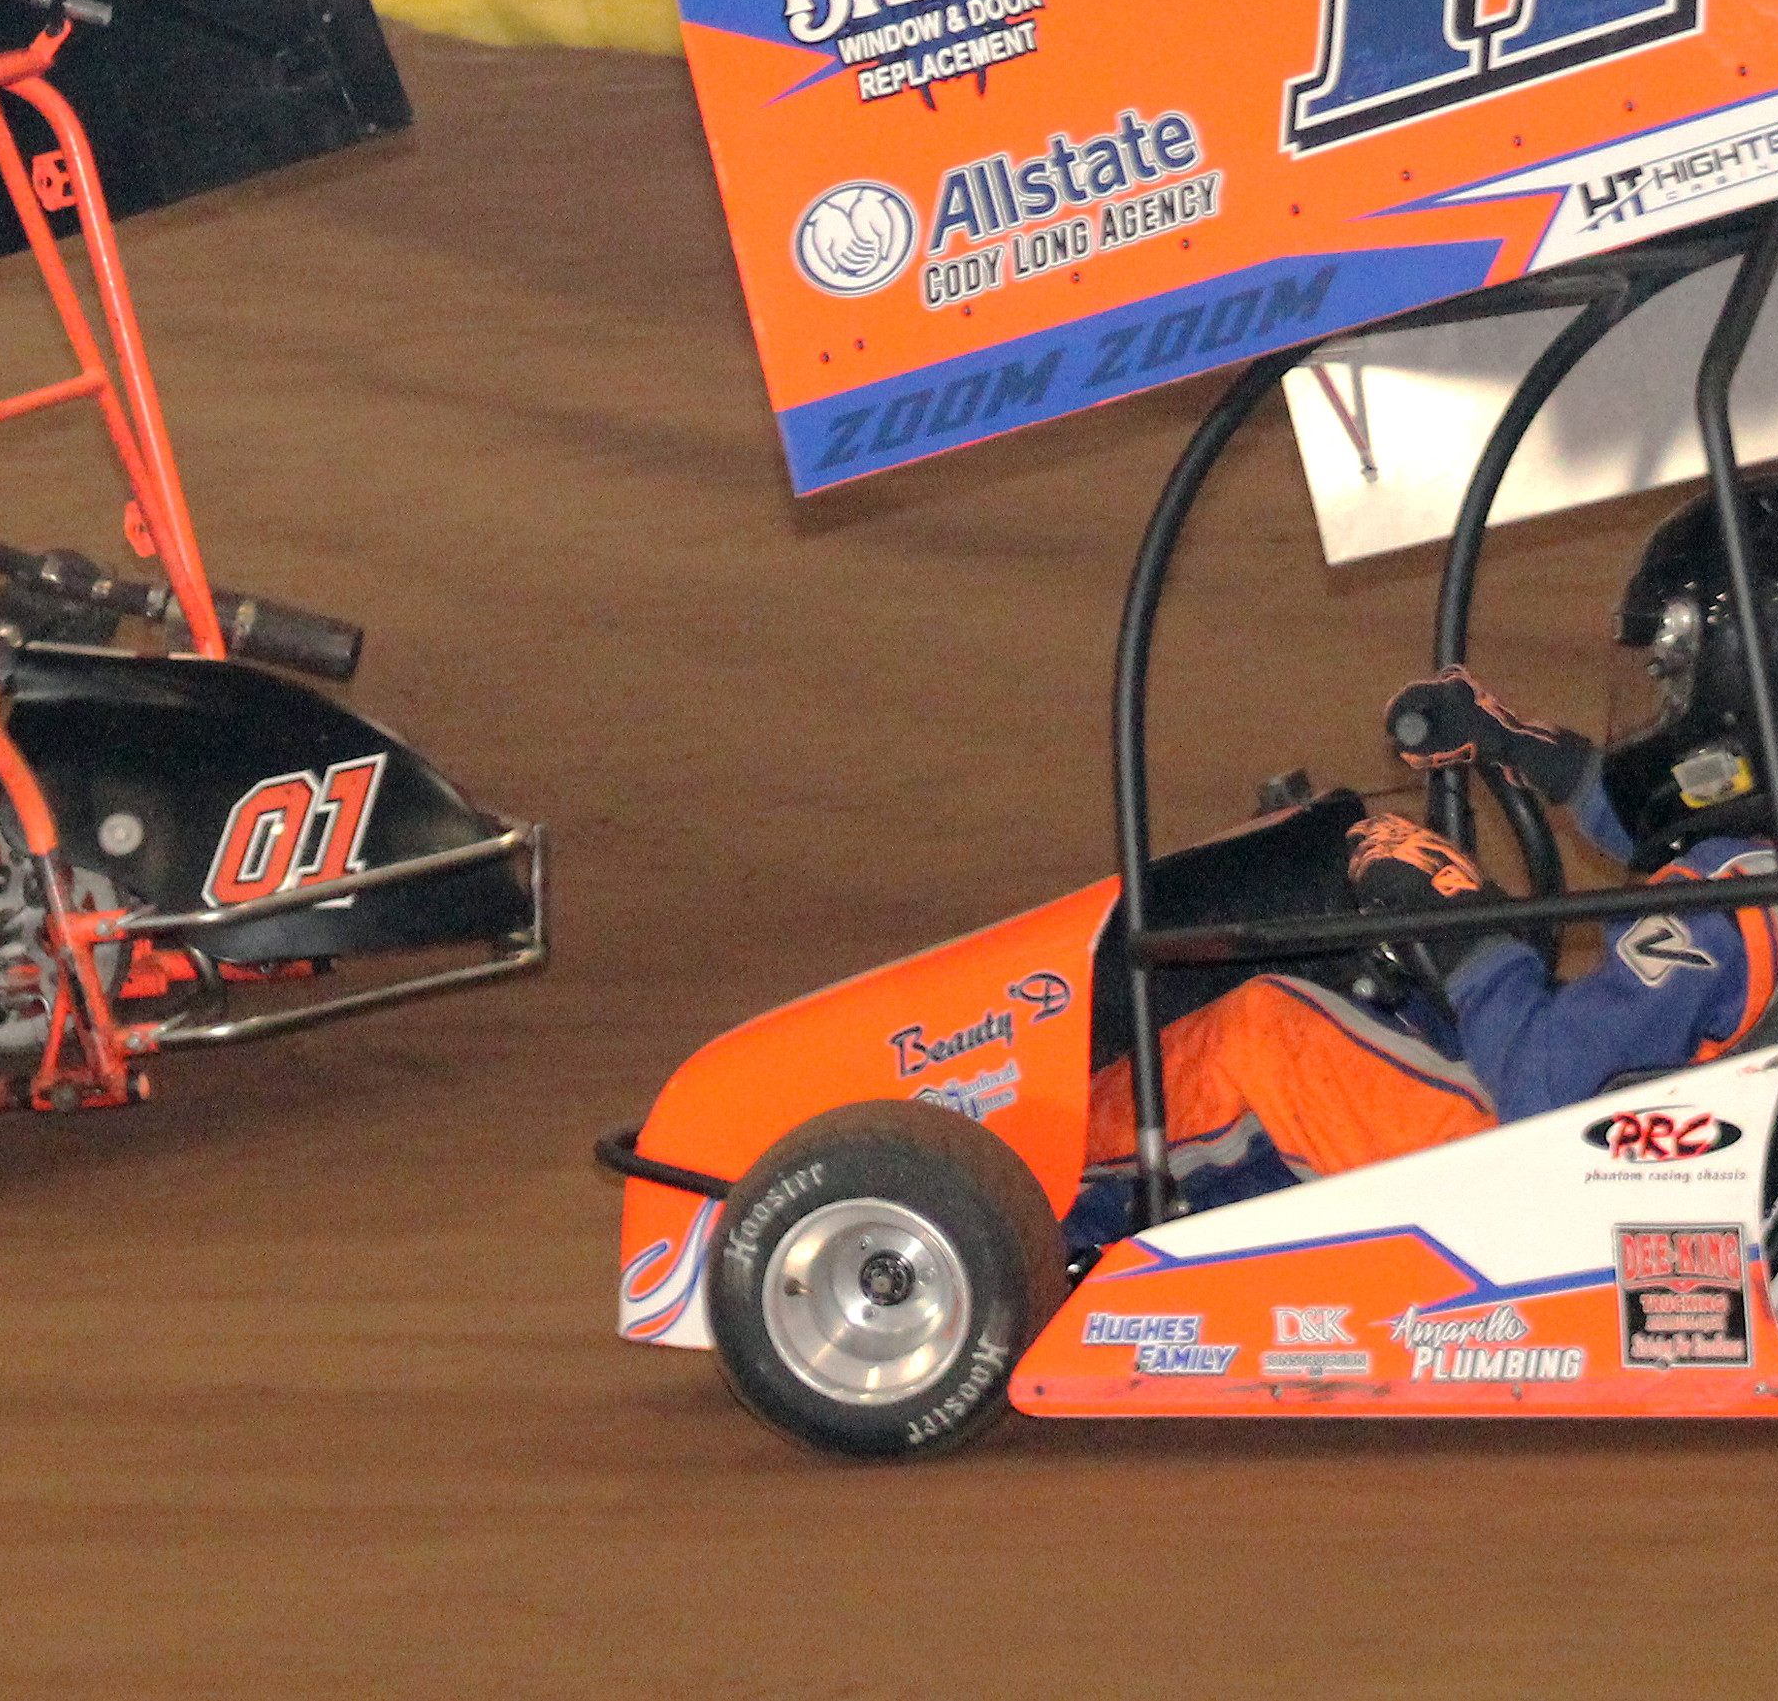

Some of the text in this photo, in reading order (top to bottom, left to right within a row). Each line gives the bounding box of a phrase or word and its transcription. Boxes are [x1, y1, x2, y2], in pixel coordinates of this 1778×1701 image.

[837, 8, 943, 65] WINDOW
[945, 7, 967, 33] &
[857, 20, 1038, 103] REPLACEMENT
[928, 111, 1200, 255] Allstate
[924, 172, 1220, 310] CODY LONG AGENCY
[815, 264, 1340, 473] ZOOM ZOOM
[201, 751, 387, 910] 01
[889, 1011, 1015, 1078] Beauty
[1609, 1111, 1711, 1161] PRC
[1584, 1169, 1746, 1184] phantom racing chassis
[1082, 1312, 1202, 1345] HUGHES
[1272, 1307, 1354, 1345] D&K
[1390, 1303, 1528, 1350] Amarillo
[1136, 1343, 1240, 1376] FAMILY
[1411, 1345, 1585, 1383] PLUMBING
